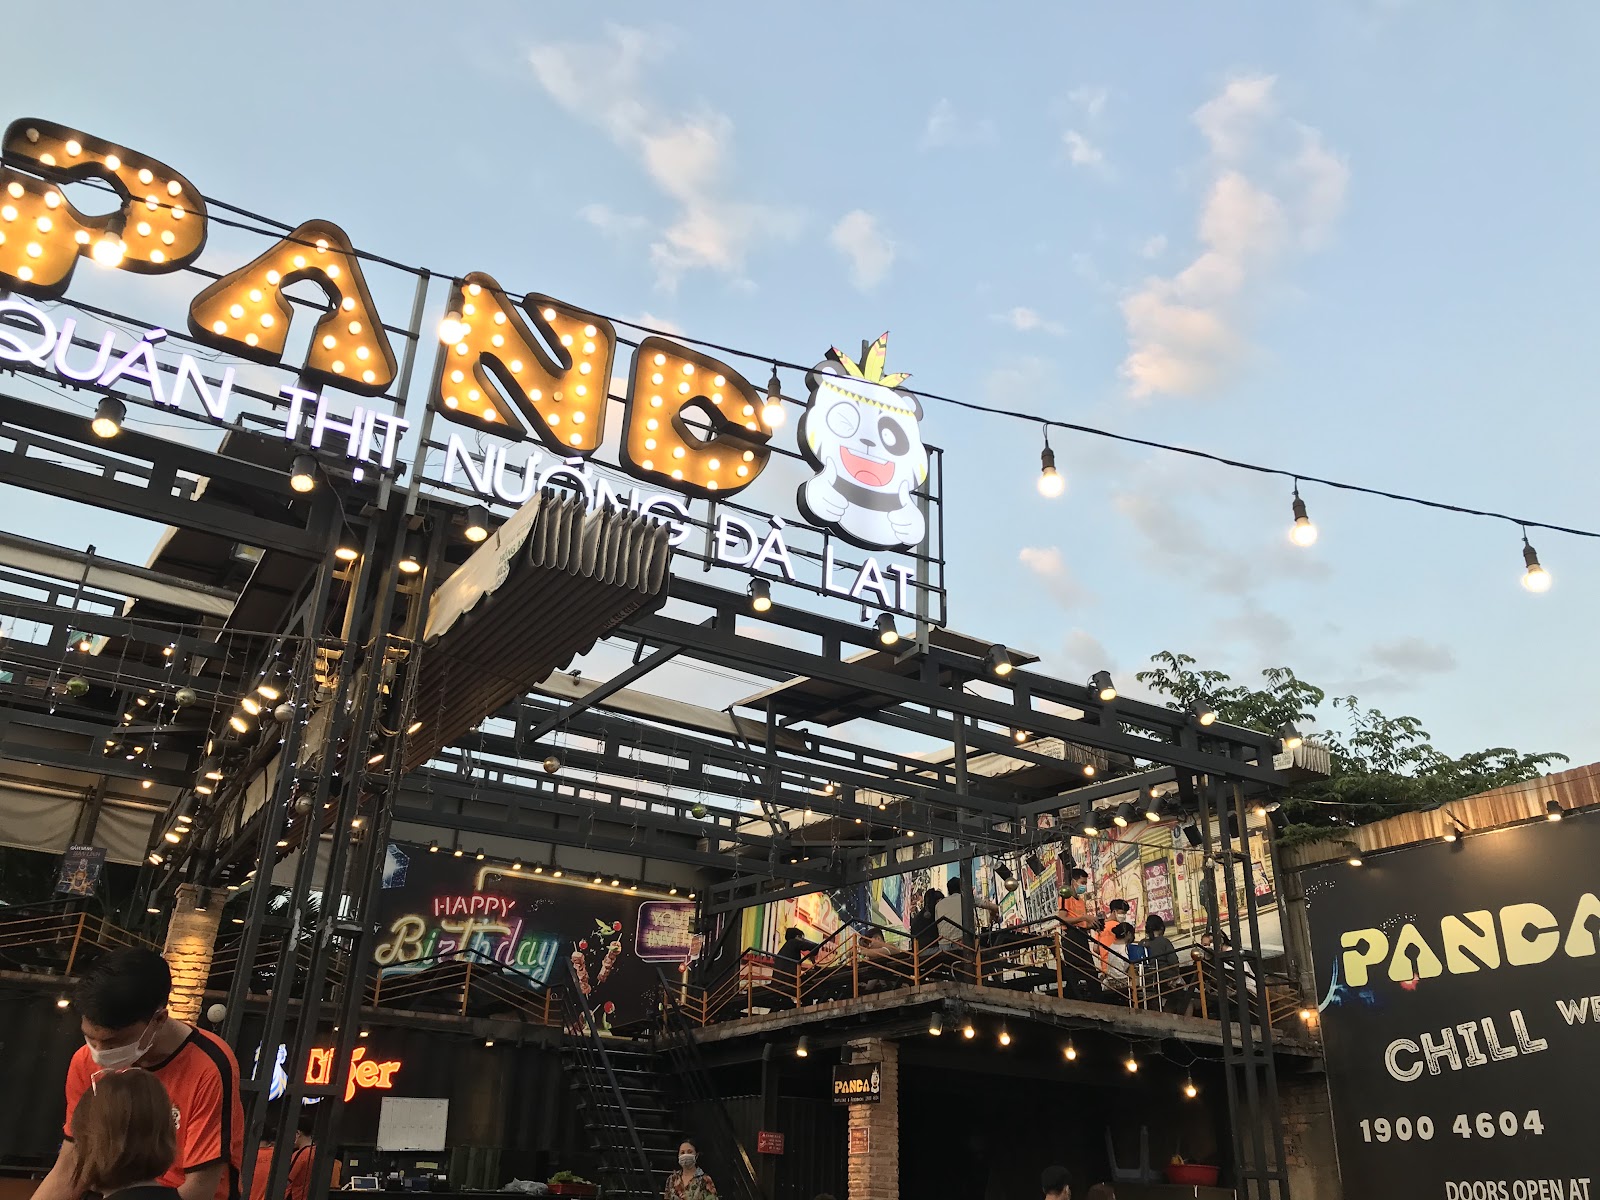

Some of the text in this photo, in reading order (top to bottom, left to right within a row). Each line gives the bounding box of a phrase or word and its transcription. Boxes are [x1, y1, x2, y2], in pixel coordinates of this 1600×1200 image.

[0, 300, 235, 420] QUÁN
[280, 384, 410, 482] THỊT
[715, 513, 796, 582] ĐÀ
[825, 544, 915, 622] LẠT
[434, 895, 516, 918] HAPPY
[374, 914, 558, 990] Birthday
[1384, 1009, 1549, 1082] CHILL
[834, 1078, 871, 1094] PANDA
[1359, 1109, 1545, 1143] 1900 4604
[1445, 1178, 1591, 1200] DOORS OPEN AT
